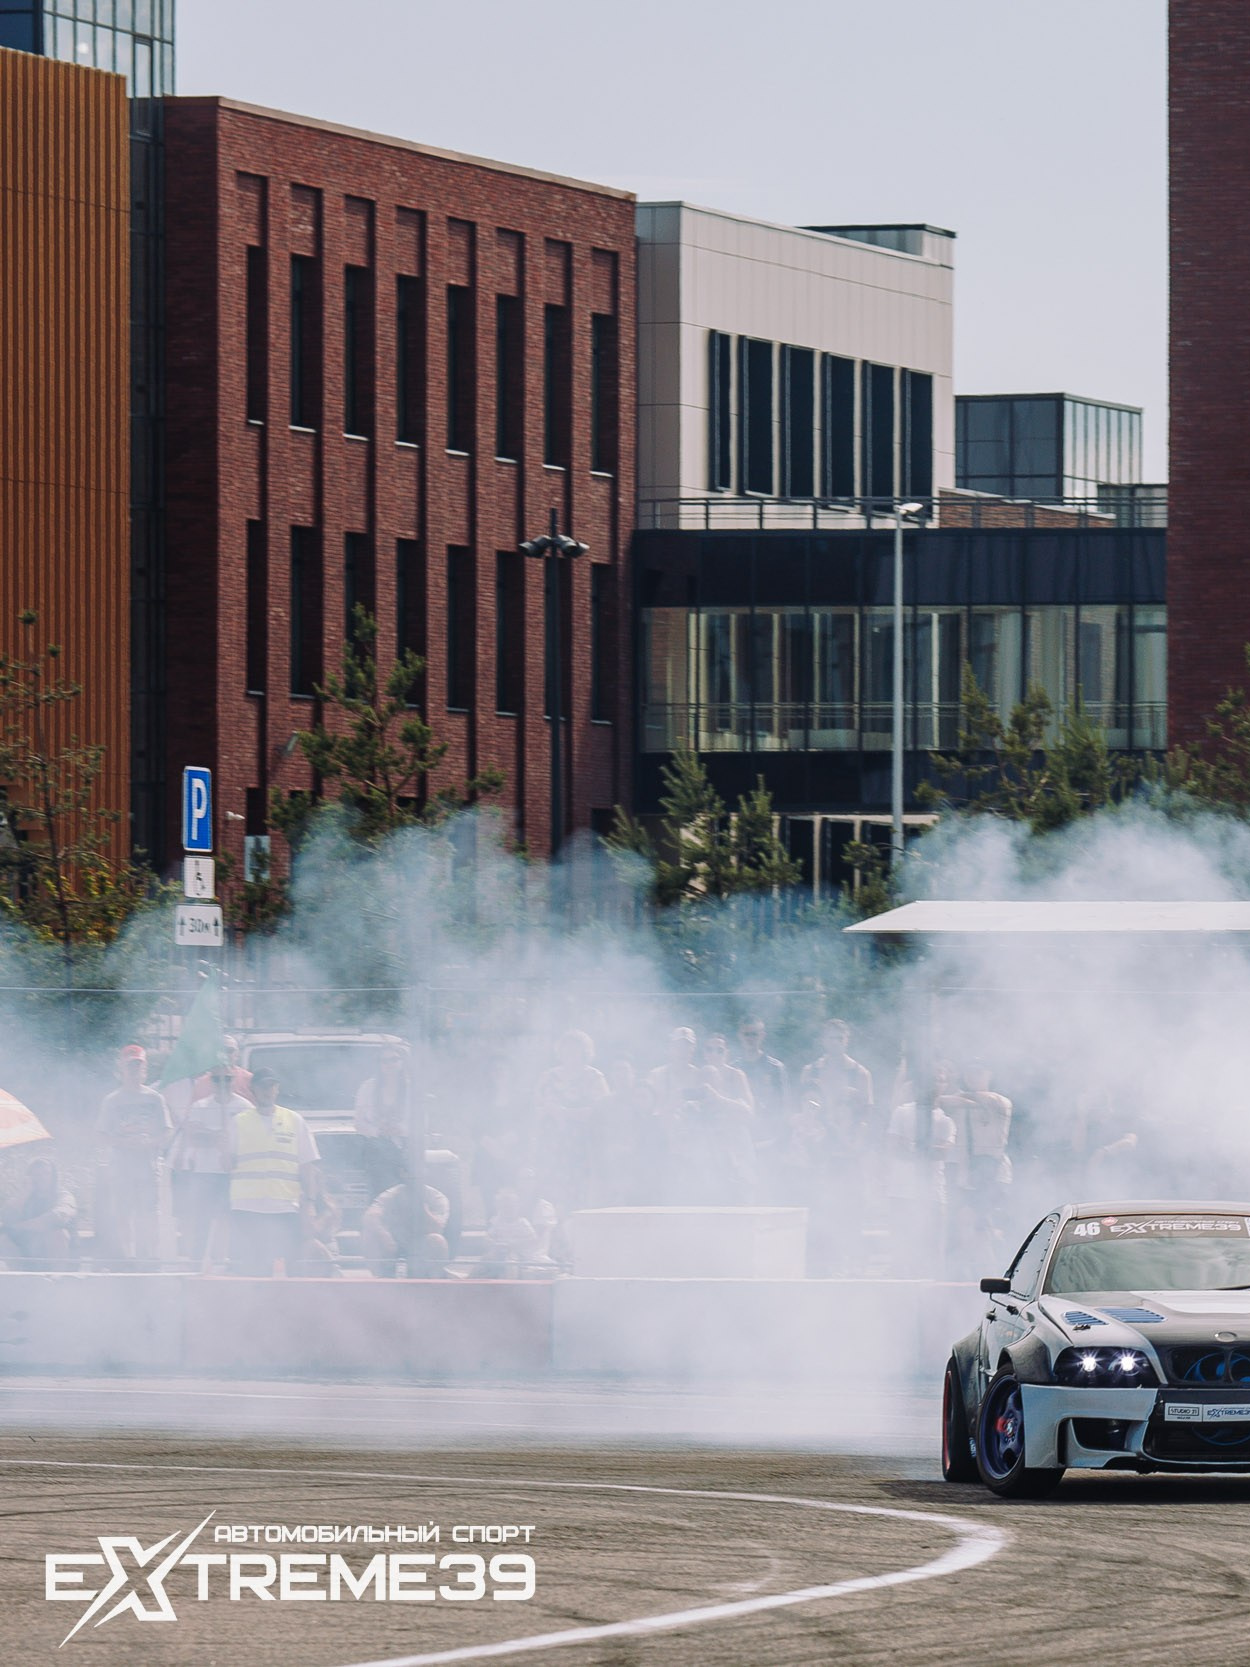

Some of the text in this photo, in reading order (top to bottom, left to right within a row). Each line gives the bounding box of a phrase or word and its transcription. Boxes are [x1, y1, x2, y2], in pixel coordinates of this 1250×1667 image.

[191, 778, 208, 841] P
[1073, 1221, 1100, 1237] 46
[1110, 1219, 1242, 1237] EXTREME39
